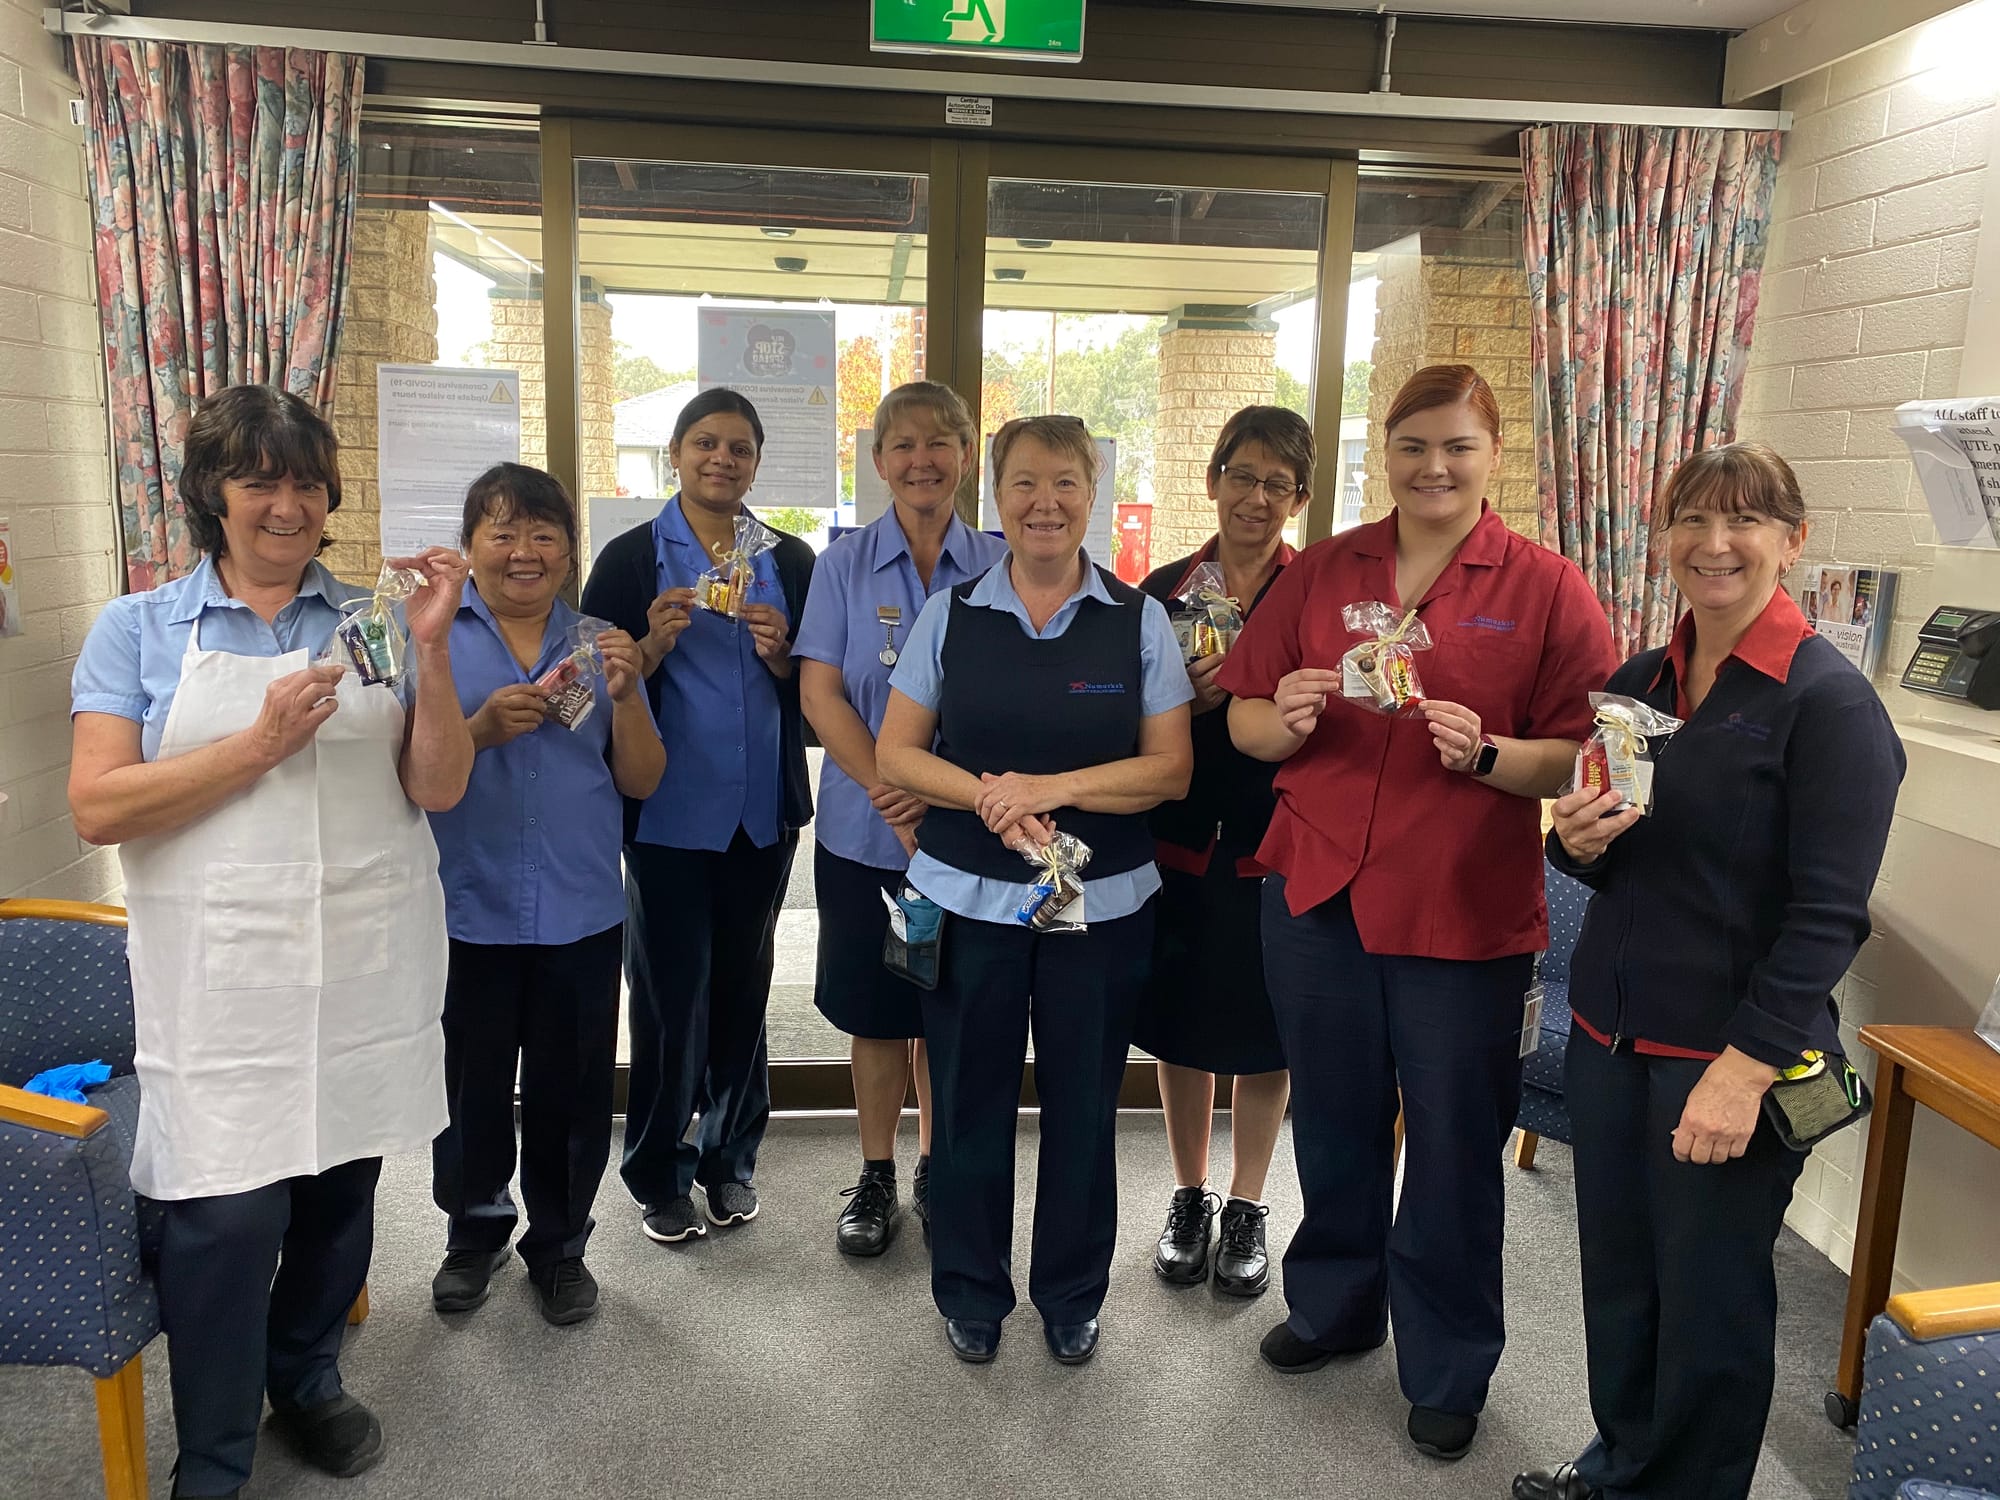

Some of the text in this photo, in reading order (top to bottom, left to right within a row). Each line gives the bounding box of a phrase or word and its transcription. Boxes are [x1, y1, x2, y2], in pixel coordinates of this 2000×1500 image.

[1934, 409, 1957, 421] ALL
[1959, 407, 1988, 421] staff
[1837, 629, 1863, 643] vision
[1835, 641, 1860, 651] australia
